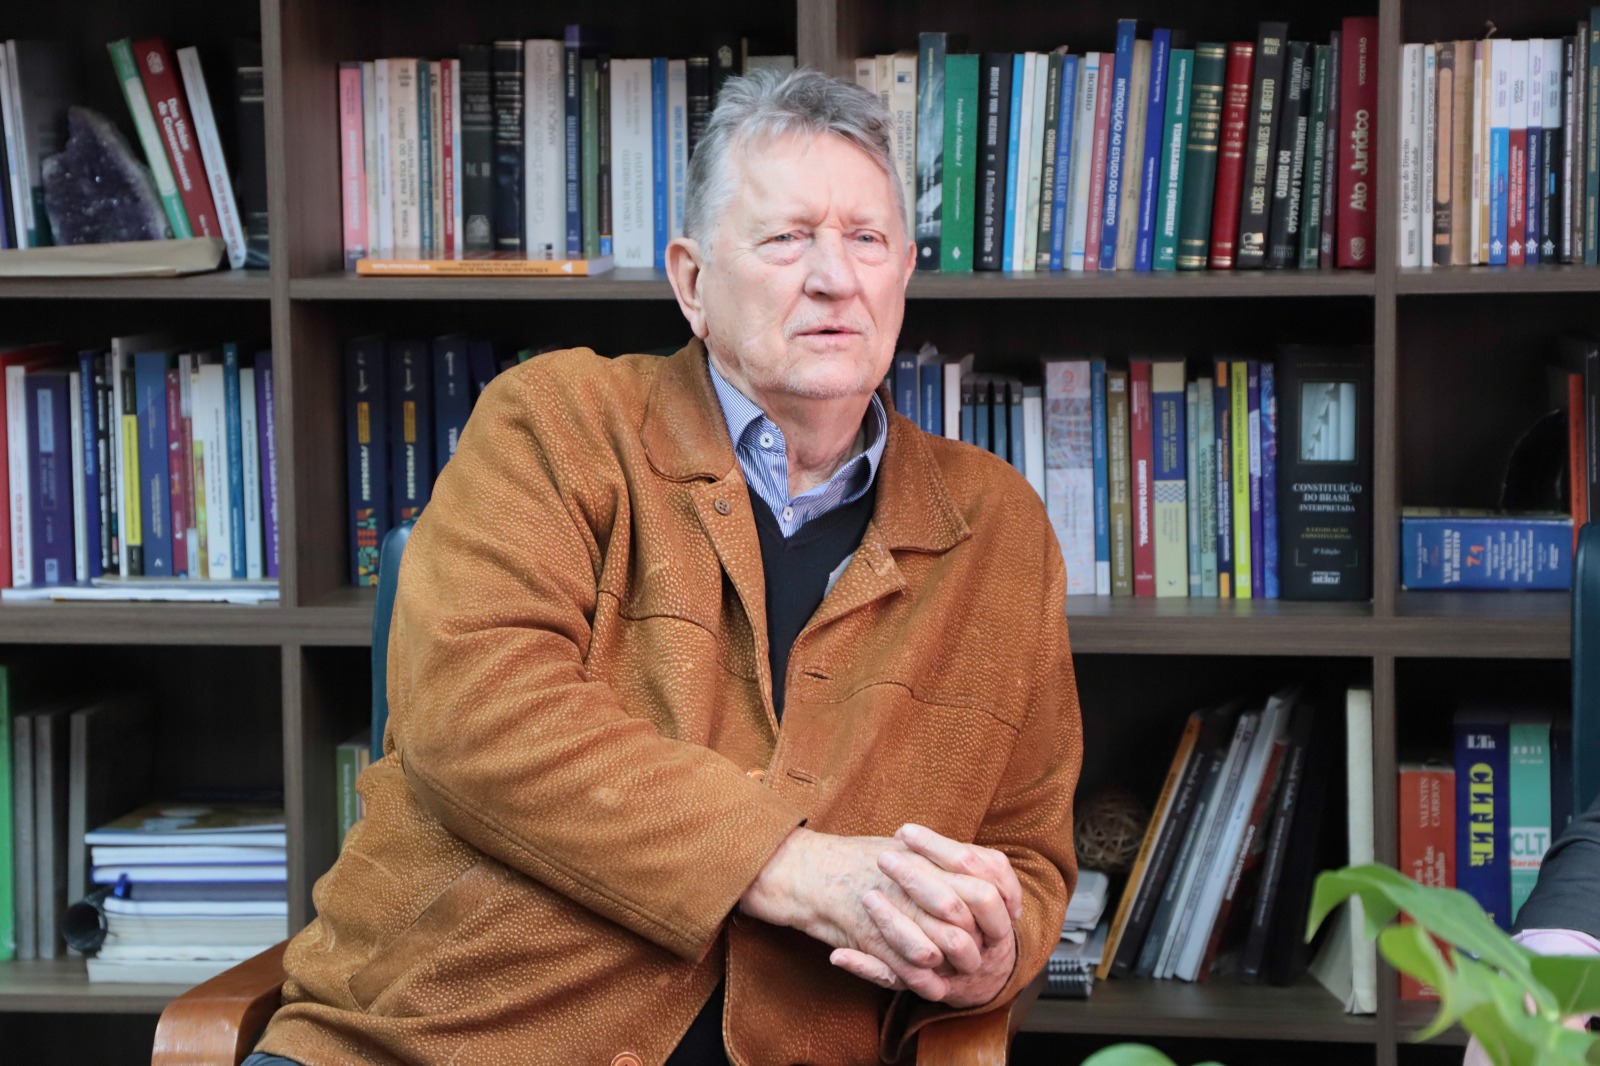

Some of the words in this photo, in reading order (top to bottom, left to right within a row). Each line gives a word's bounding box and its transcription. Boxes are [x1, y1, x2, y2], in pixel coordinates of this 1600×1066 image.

[990, 66, 1000, 96] RUDOLF
[1290, 57, 1303, 99] MAXIMILIANO
[1358, 55, 1367, 86] VICENTE
[532, 47, 543, 127] Administrativo
[548, 74, 556, 105] JUSTEN
[1086, 73, 1096, 110] BOBBIO
[1261, 78, 1275, 110] DIREITO
[897, 110, 904, 122] DO
[990, 98, 999, 113] VON
[1114, 78, 1126, 130] INTRODUÇÃO
[1260, 112, 1271, 123] DE
[532, 130, 544, 168] Direito
[567, 116, 576, 180] ADMINISTRATIVO
[674, 130, 682, 139] DO
[1046, 129, 1056, 165] JURÍDICO
[1113, 133, 1122, 145] AO
[1314, 121, 1324, 157] JURÍDICO
[1327, 129, 1336, 149] Direito
[1350, 109, 1369, 176] Jurídico
[162, 117, 192, 191] Consentimento
[399, 144, 406, 155] DO
[1096, 130, 1104, 173] INTRODUÇÃO
[1110, 147, 1120, 178] ESTUDO
[1169, 123, 1182, 180] COMPETÊNCIA
[1253, 126, 1271, 184] PRELIMINARES
[1280, 150, 1291, 164] DO
[1402, 139, 1410, 168] Direito
[533, 173, 544, 187] de
[622, 149, 630, 187] DIREITO
[905, 151, 914, 185] PRÁTICA
[1045, 166, 1054, 188] FATO
[1058, 156, 1068, 183] EMANUEL
[1275, 166, 1290, 198] DIREITO
[1313, 160, 1321, 180] FATO
[1402, 170, 1409, 180] do
[1411, 147, 1419, 201] Solidariedade
[1426, 163, 1432, 174] DO
[567, 183, 576, 212] DIREITO
[623, 190, 631, 200] DE
[635, 152, 644, 228] ADMINISTRATIVO
[985, 177, 995, 214] Finalidade
[1044, 190, 1052, 201] DO
[1056, 185, 1067, 202] KANT
[1109, 180, 1118, 192] DO
[1250, 187, 1266, 214] LIÇÕES
[1312, 183, 1320, 195] DO
[1324, 185, 1333, 216] Questões
[1350, 183, 1369, 211] Ato
[1402, 182, 1411, 213] Origem
[533, 192, 544, 223] Curso
[623, 202, 631, 232] CURSO
[985, 216, 994, 225] do
[1042, 204, 1052, 232] TEORIA
[1093, 206, 1099, 215] DO
[1106, 194, 1116, 225] DIREITO
[1164, 189, 1177, 236] JURISDIÇÃO
[1286, 187, 1301, 233] APLICAÇÃO
[1311, 197, 1320, 226] TEORIA
[1411, 203, 1418, 213] de
[984, 227, 993, 252] Direito
[1207, 445, 1216, 466] Social
[1138, 460, 1147, 496] DIREITO
[1200, 448, 1209, 498] Consolidação
[1292, 482, 1362, 493] CONSTITUIÇÃO
[1208, 467, 1216, 509] Previdência
[1303, 494, 1318, 502] DO
[1319, 494, 1352, 502] BRASIL
[1138, 497, 1148, 546] MUNICIPAL
[1298, 504, 1355, 512] INTERPRETADA
[1444, 529, 1452, 560] MECUM
[1453, 571, 1460, 581] DE
[1466, 556, 1481, 567] 7
[1512, 746, 1541, 755] 2011
[1419, 777, 1429, 828] VALENTIN
[1432, 780, 1441, 827] CARRION
[1424, 846, 1434, 864] das
[1511, 833, 1546, 855] CLT
